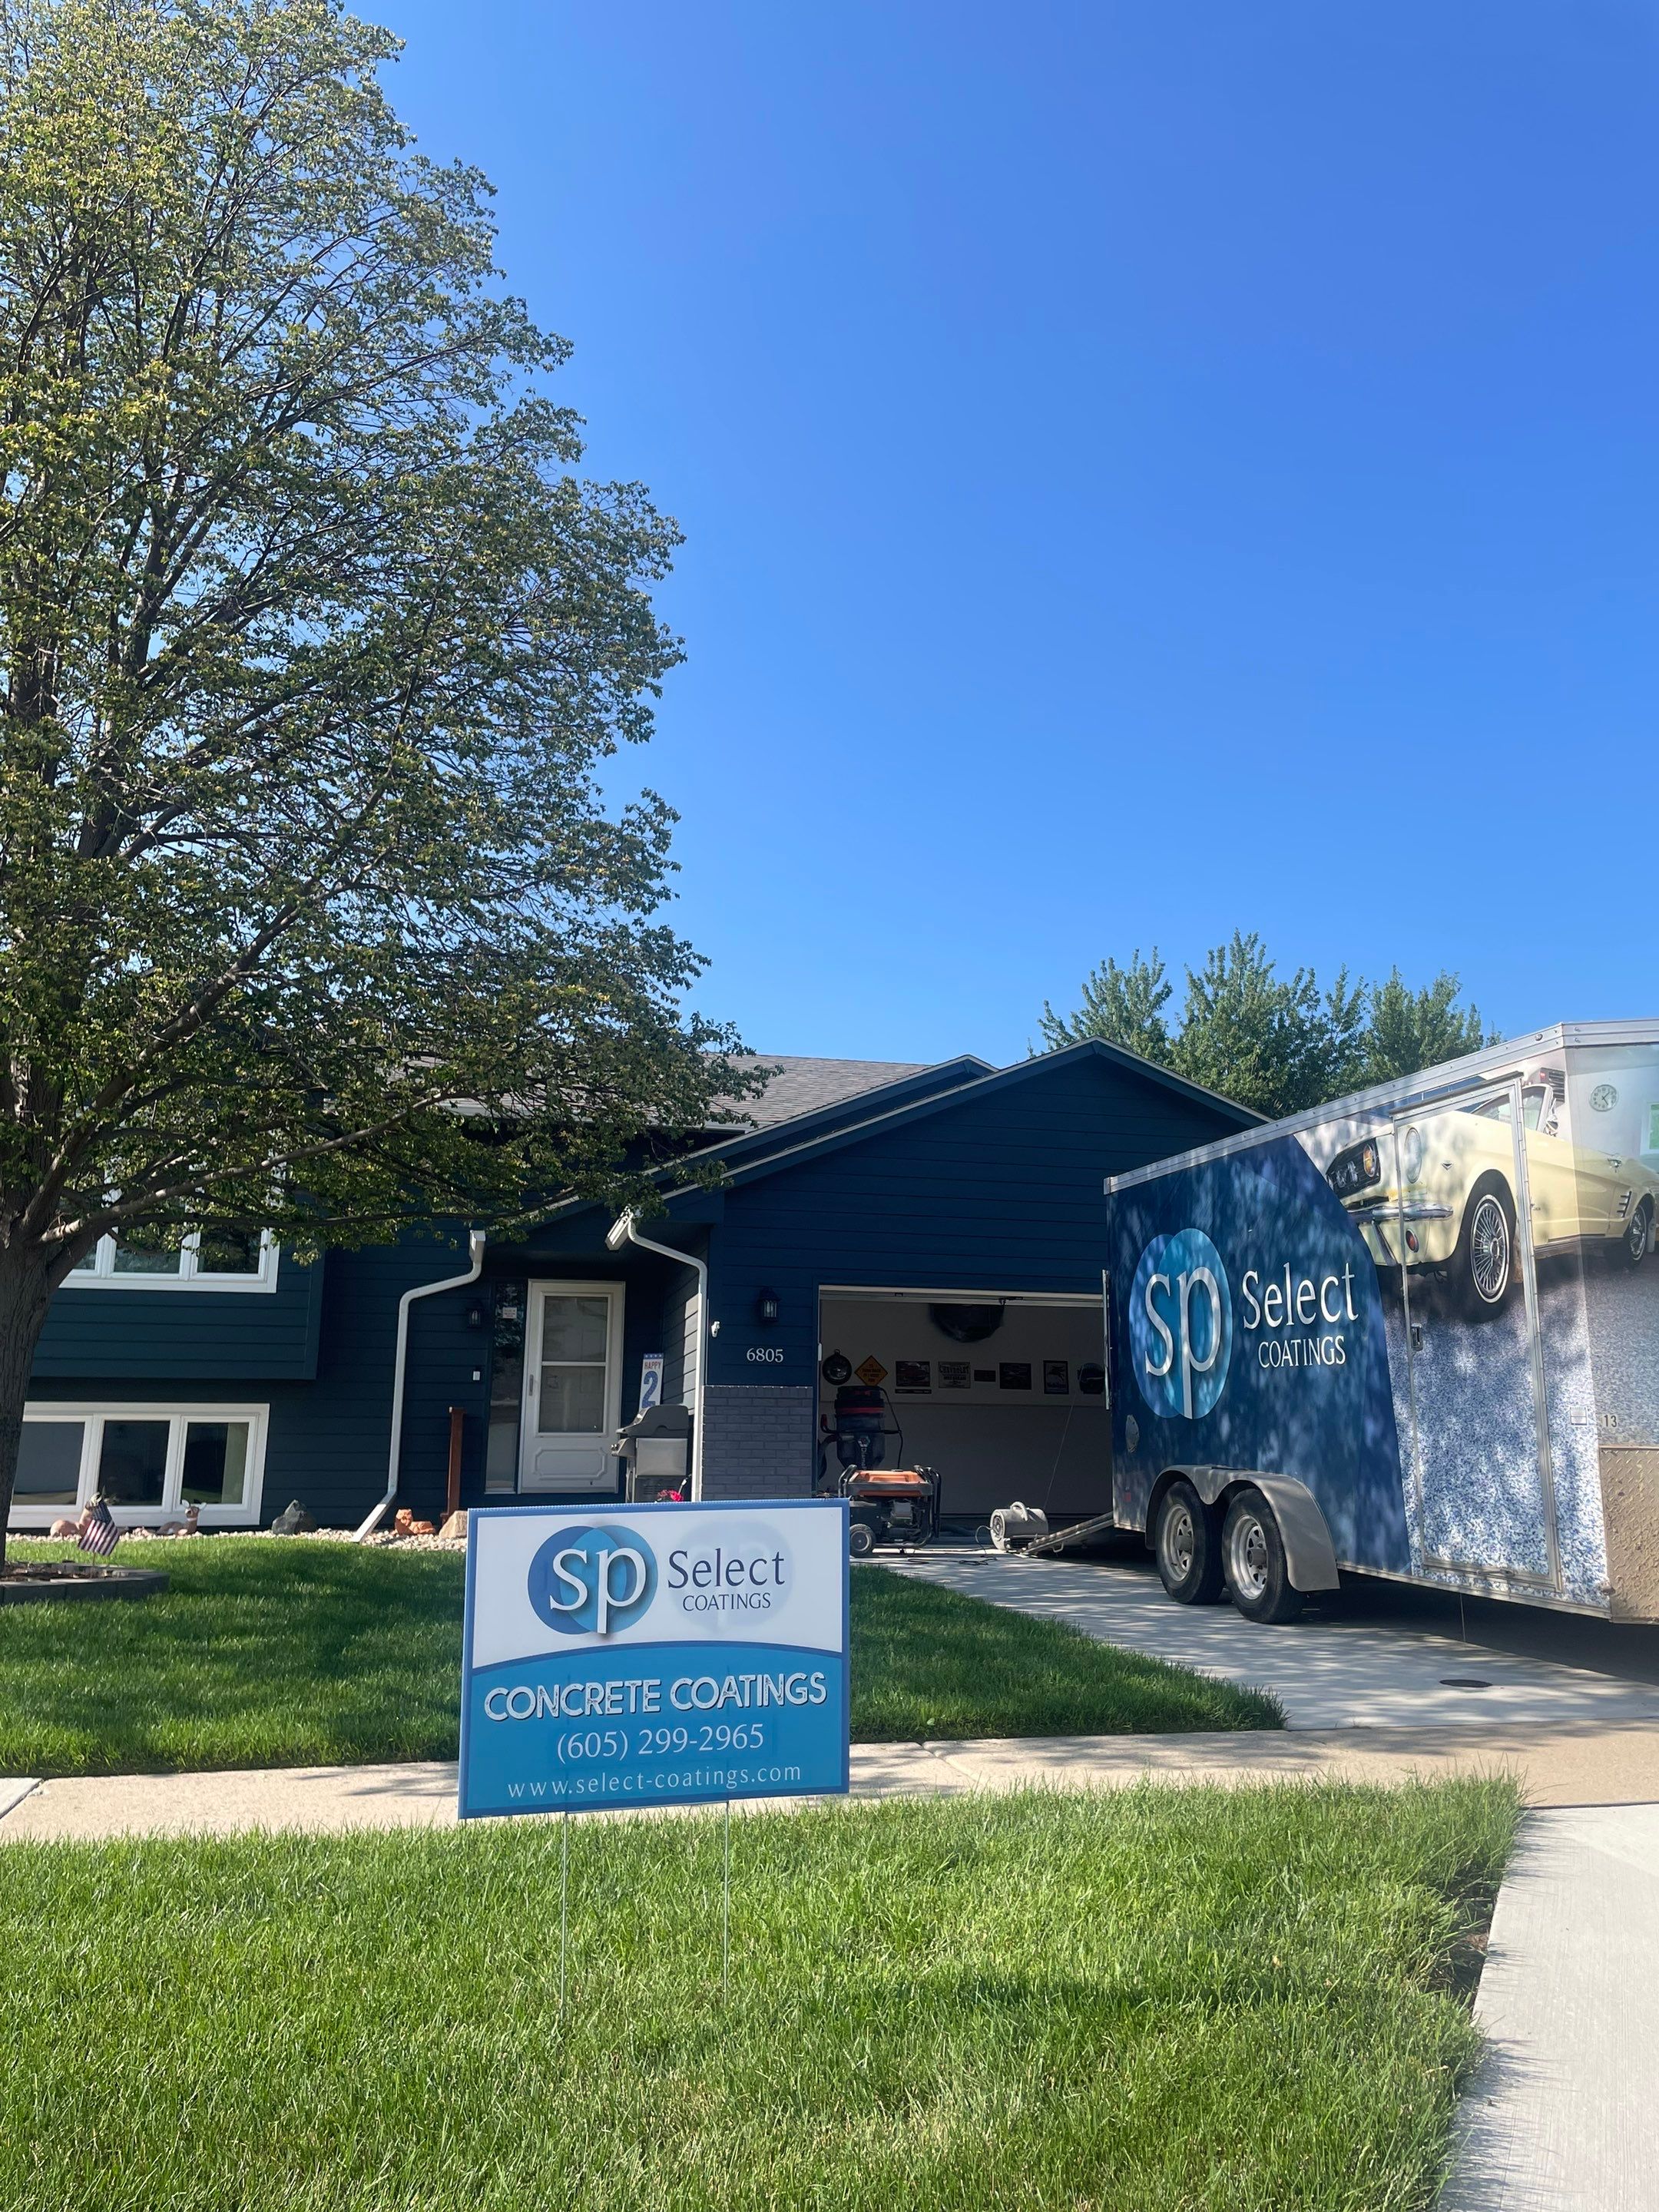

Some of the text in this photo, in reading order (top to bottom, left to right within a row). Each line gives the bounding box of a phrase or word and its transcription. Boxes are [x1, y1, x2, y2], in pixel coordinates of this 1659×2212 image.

[1243, 1262, 1359, 1330] Select
[747, 1347, 783, 1363] 6805
[1144, 1267, 1221, 1419] sp
[1258, 1335, 1346, 1368] COATINGS
[644, 1361, 661, 1369] HAPPY
[1604, 1414, 1618, 1428] 13
[667, 1548, 785, 1588] Select
[549, 1546, 646, 1634] sp
[683, 1592, 771, 1612] COATINGS
[484, 1671, 827, 1721] CONCRETE COATINGS
[557, 1724, 764, 1764] (605) 299-2965
[508, 1765, 801, 1798] www.select-coatings.com
